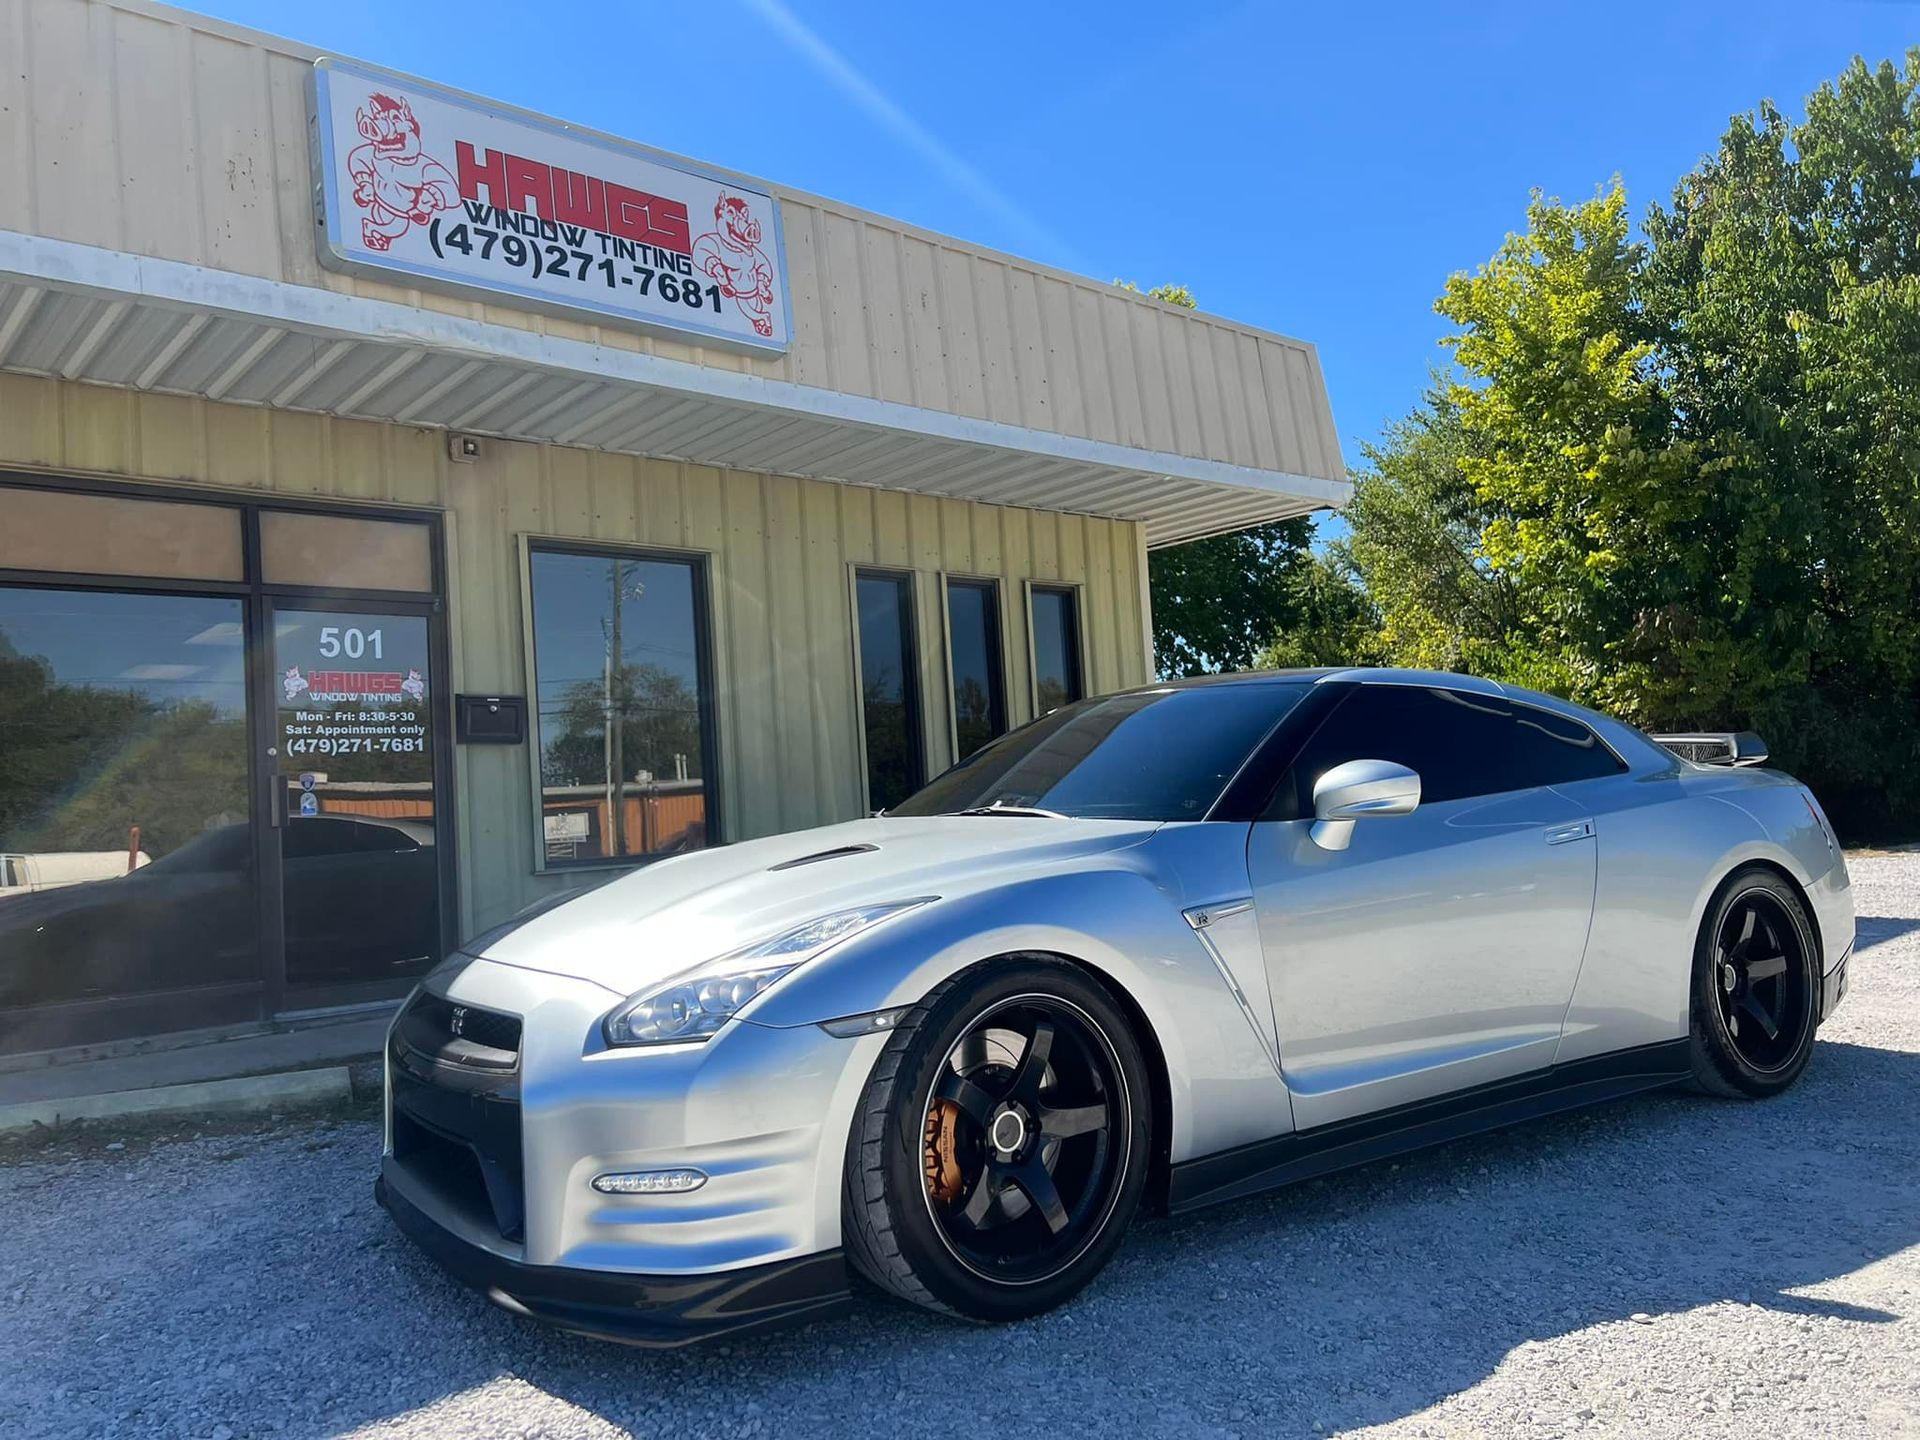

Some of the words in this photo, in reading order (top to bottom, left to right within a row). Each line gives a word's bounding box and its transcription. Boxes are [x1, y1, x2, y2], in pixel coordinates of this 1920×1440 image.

[456, 140, 691, 256] HAWGS
[462, 199, 587, 247] WINDOW
[595, 232, 692, 276] TINTING
[430, 217, 721, 314] (479)271-7681
[319, 627, 383, 659] 501
[308, 671, 402, 693] HAWGS
[309, 692, 358, 702] WINDOW
[361, 693, 402, 702] TINTING
[296, 711, 323, 721] Mon
[335, 711, 355, 721] Fri:
[286, 724, 312, 735] Sat:
[315, 724, 397, 737] Appointment
[400, 724, 425, 736] only
[287, 738, 424, 757] (479)271-7681
